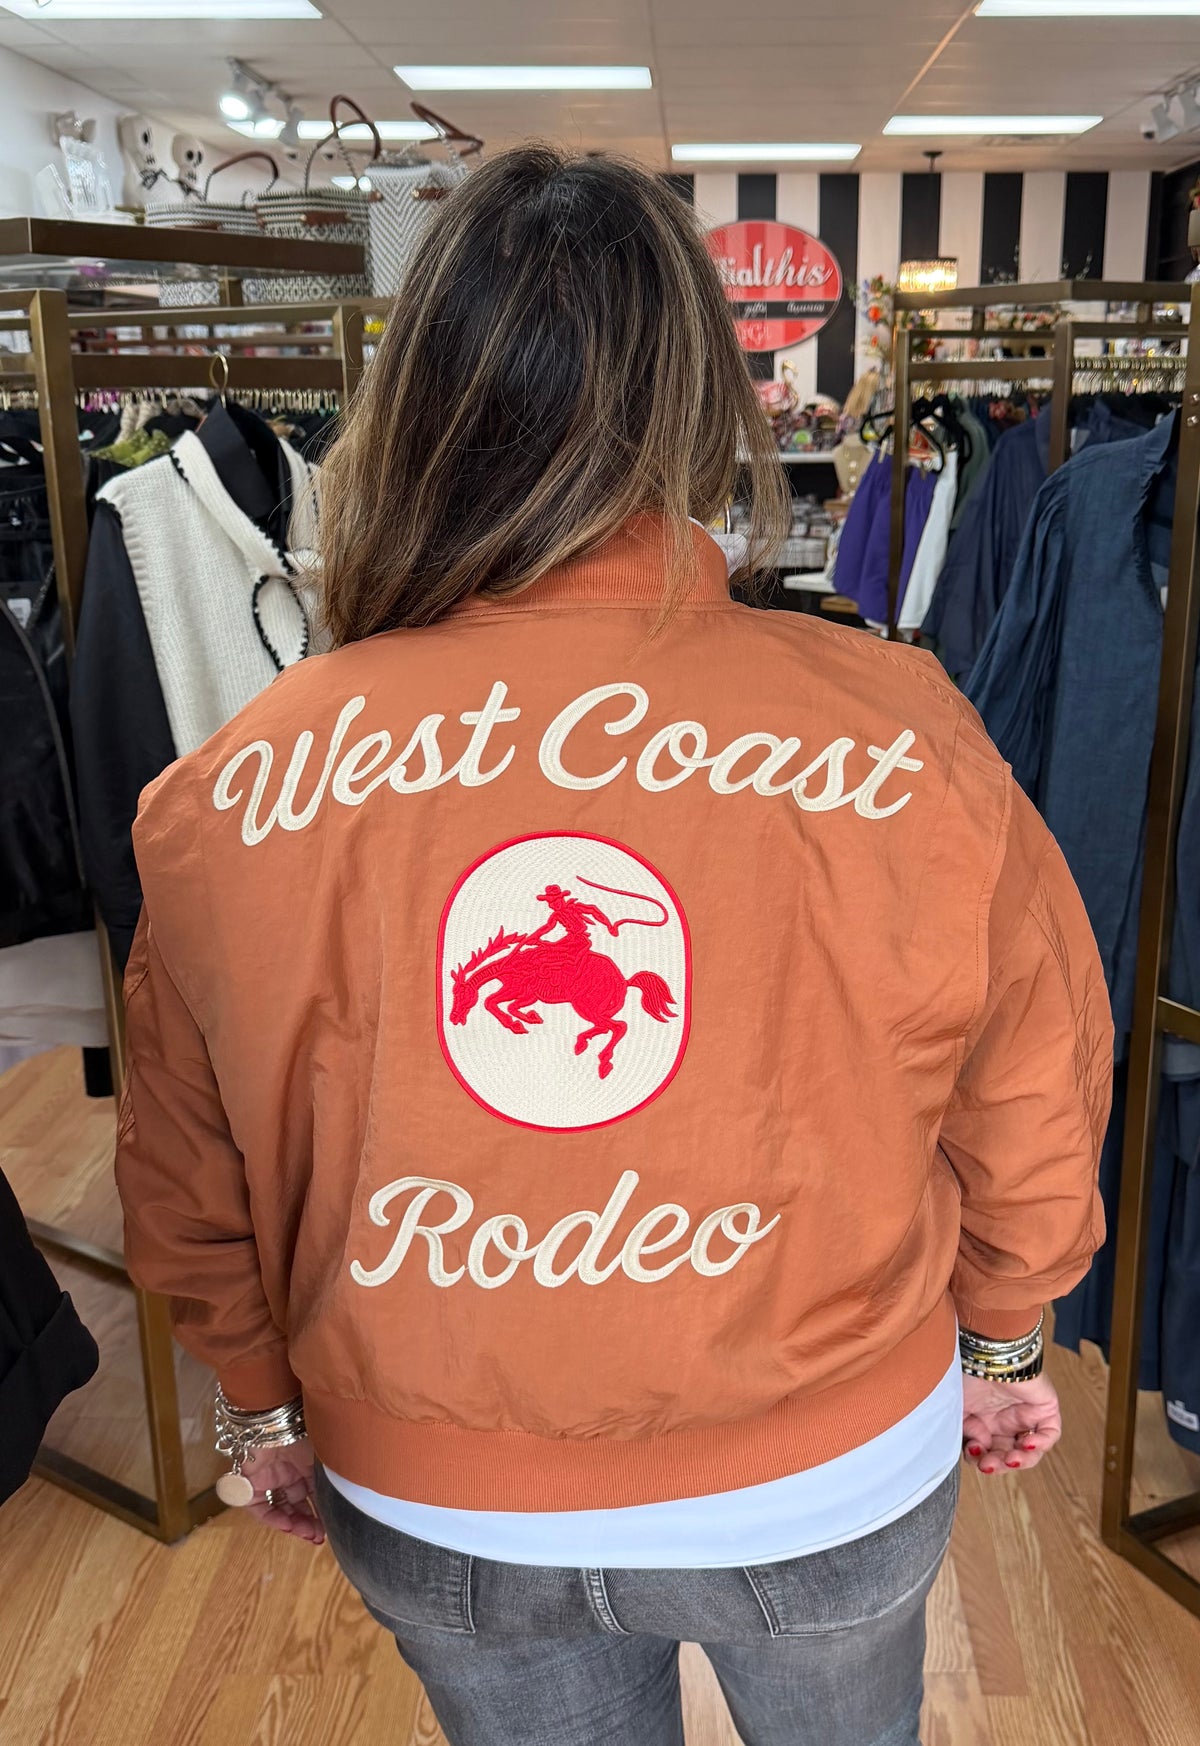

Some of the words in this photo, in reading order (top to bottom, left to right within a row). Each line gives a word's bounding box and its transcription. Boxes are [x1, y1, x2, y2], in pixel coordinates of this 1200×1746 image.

[212, 681, 520, 847] West
[538, 682, 923, 820] Coast
[350, 1169, 781, 1290] Rodeo
